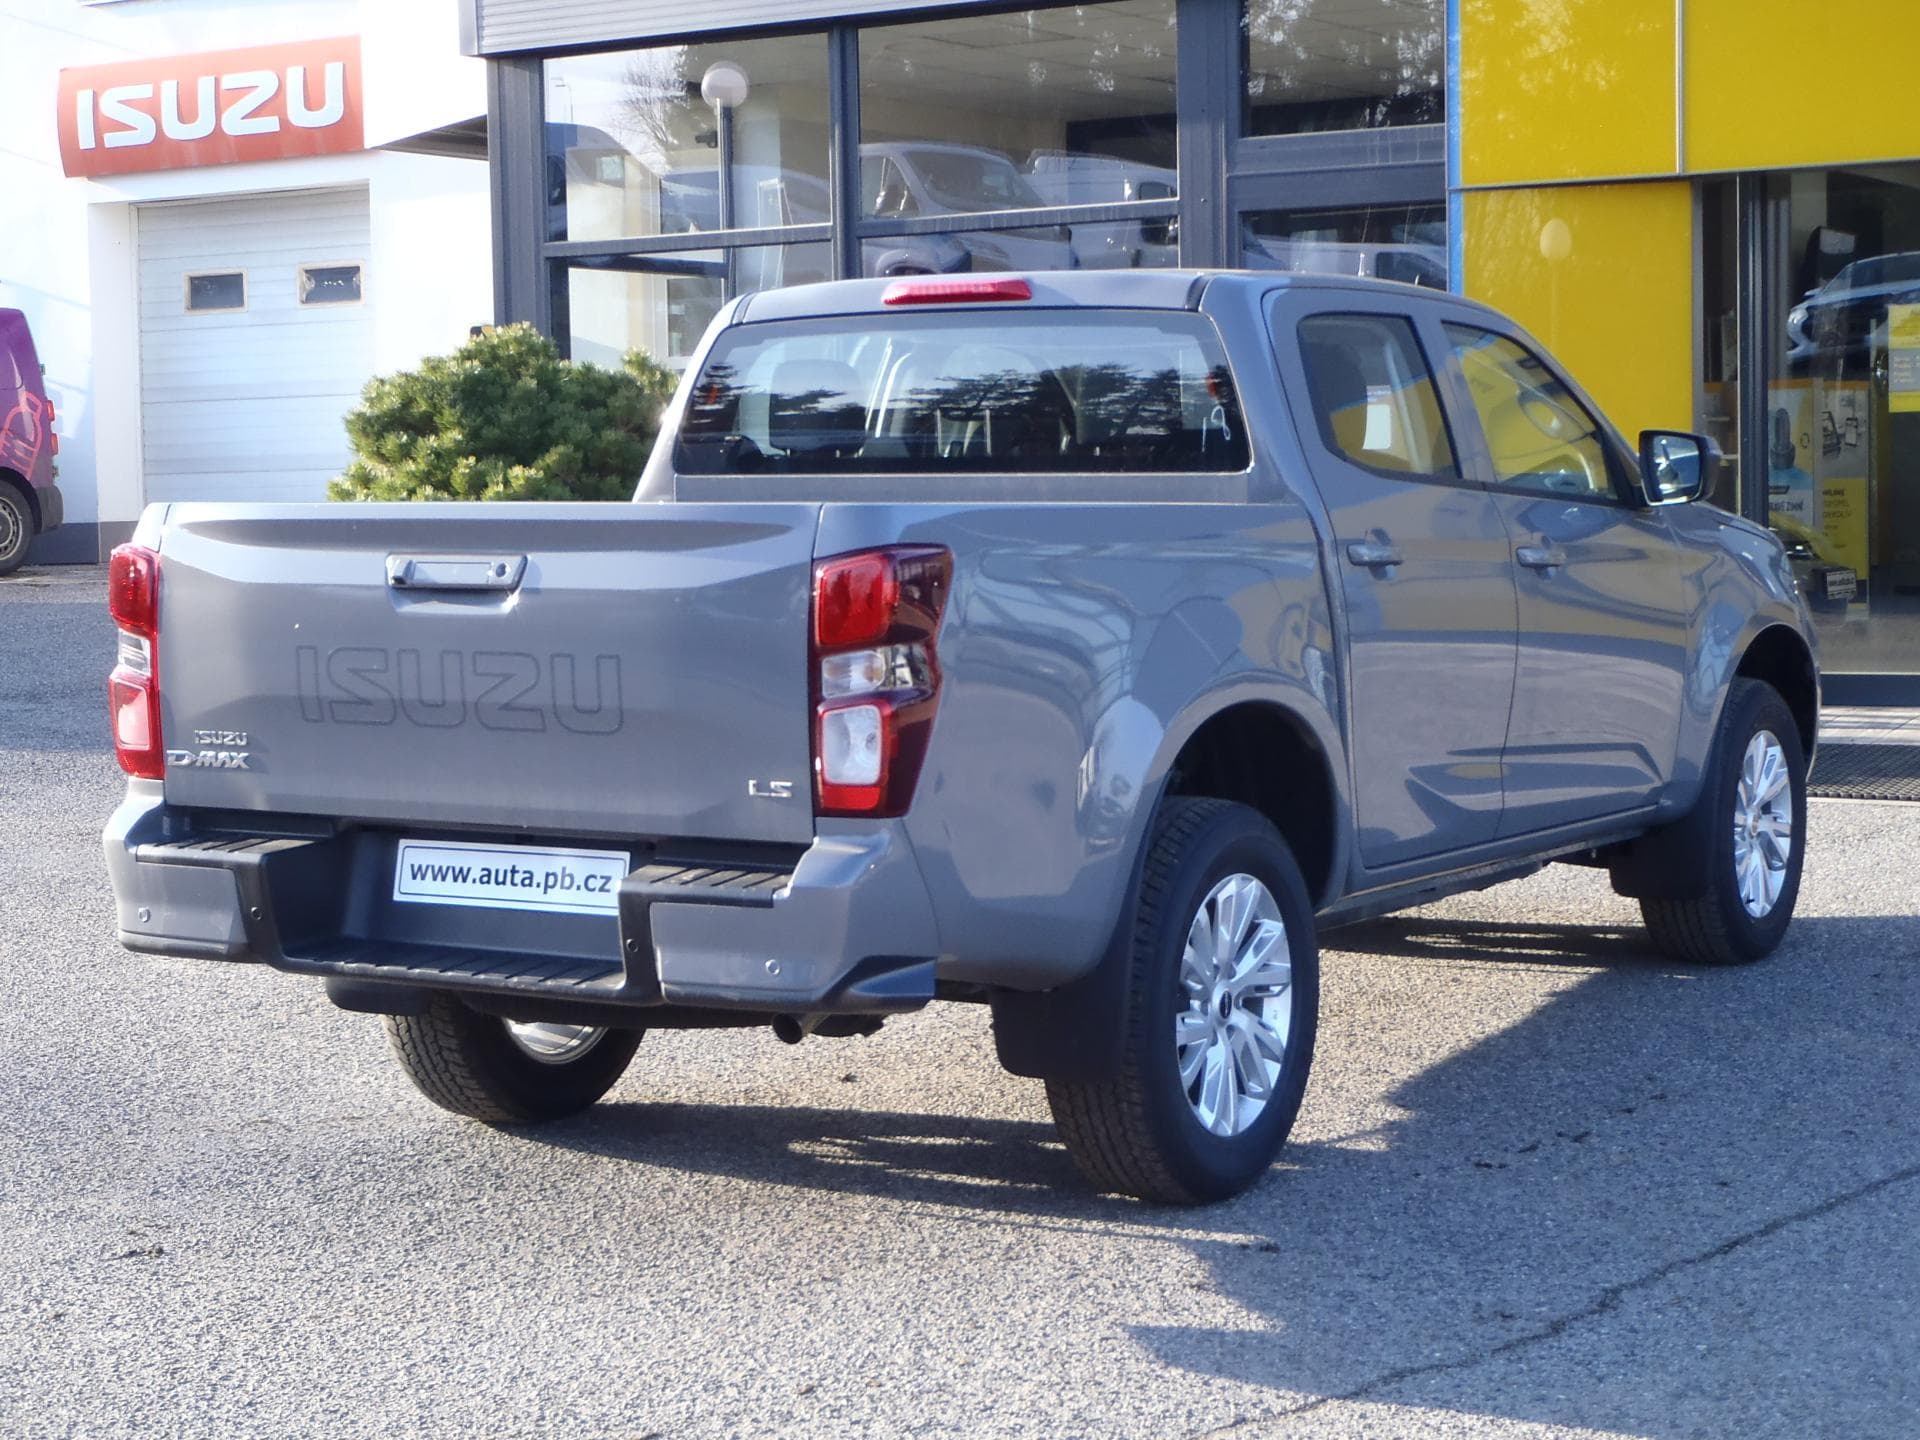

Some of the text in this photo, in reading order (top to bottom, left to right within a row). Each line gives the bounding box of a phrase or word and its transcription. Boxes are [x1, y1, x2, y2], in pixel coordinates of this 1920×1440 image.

[76, 61, 344, 150] ISUZU
[295, 645, 624, 735] ISUZU
[194, 729, 248, 746] ISUZU
[166, 749, 250, 769] D-MAX
[748, 779, 793, 798] LS
[409, 862, 613, 895] www.auta.pb.cz
